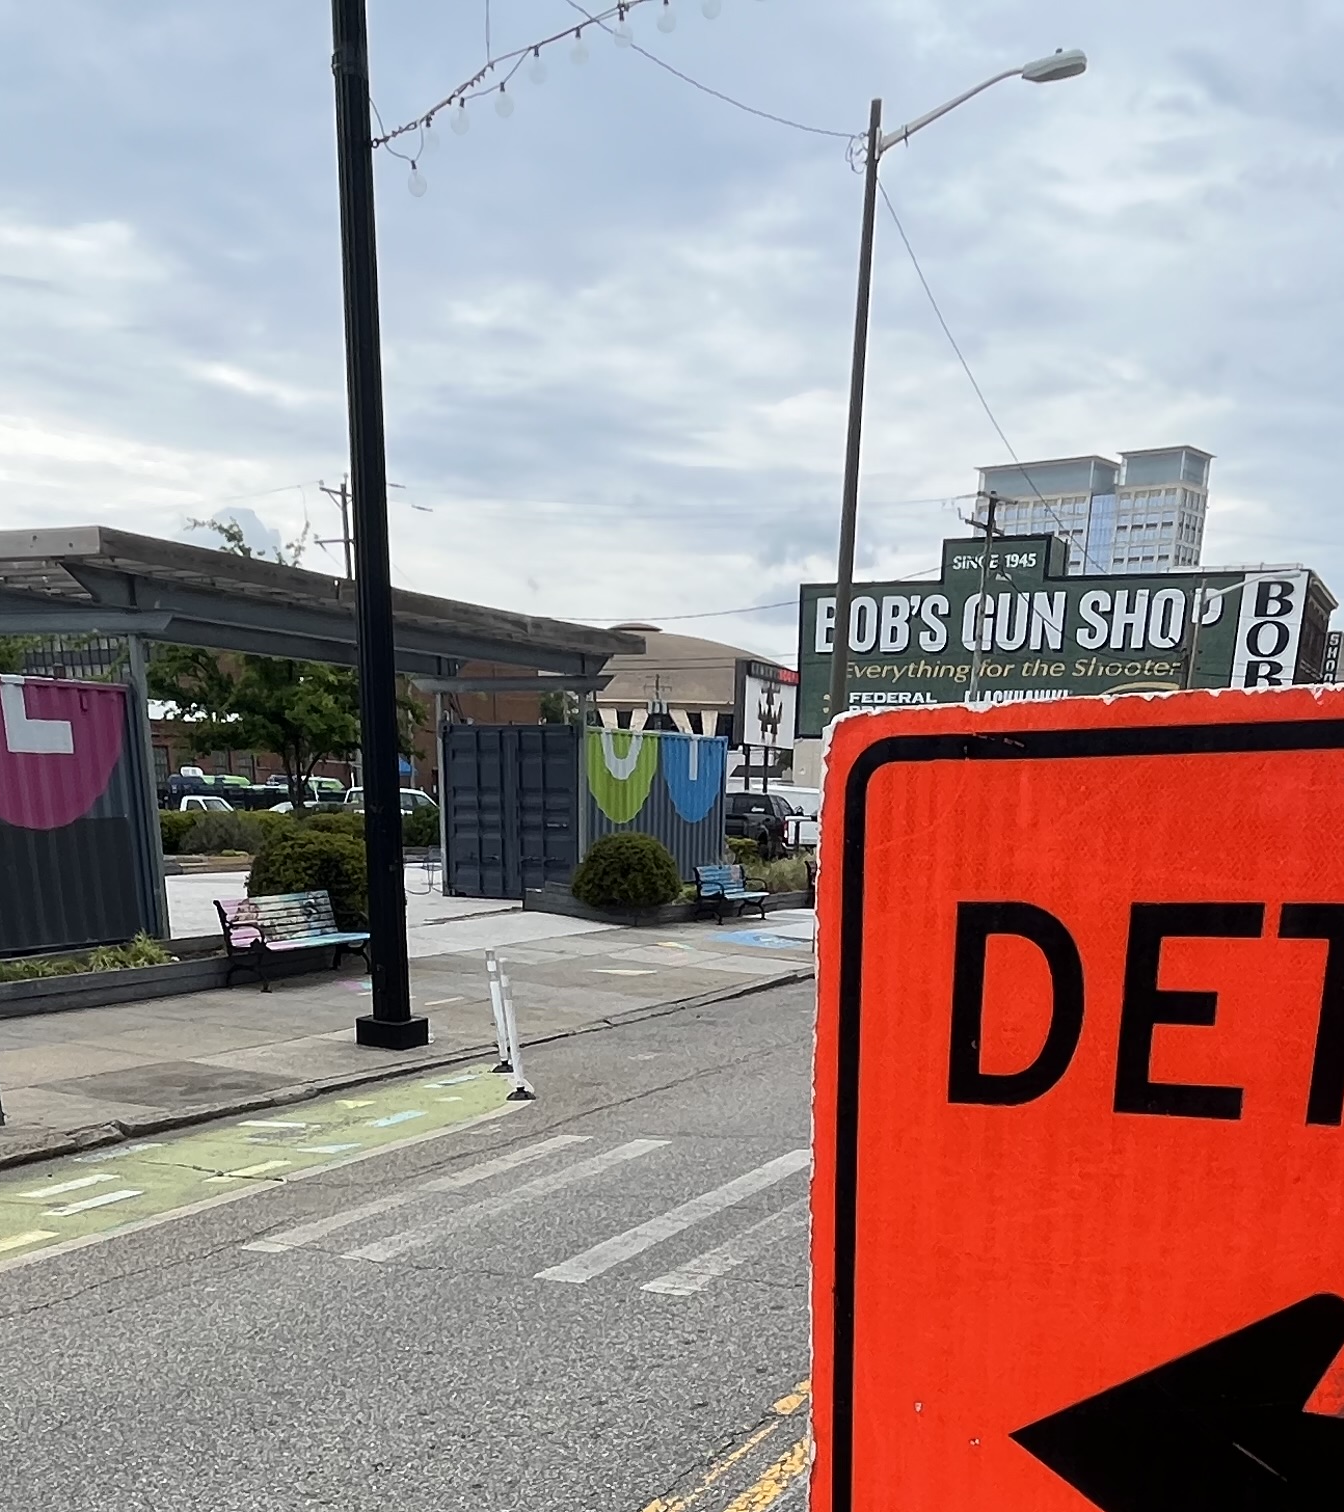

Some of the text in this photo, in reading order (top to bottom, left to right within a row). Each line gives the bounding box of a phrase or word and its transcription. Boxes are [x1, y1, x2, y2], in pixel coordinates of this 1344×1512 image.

[952, 552, 1038, 570] SINCE 1945
[815, 588, 1223, 652] BOB'S GUN SHOP
[847, 657, 1181, 683] Everything for the Shooter
[849, 692, 938, 703] FEDERAL
